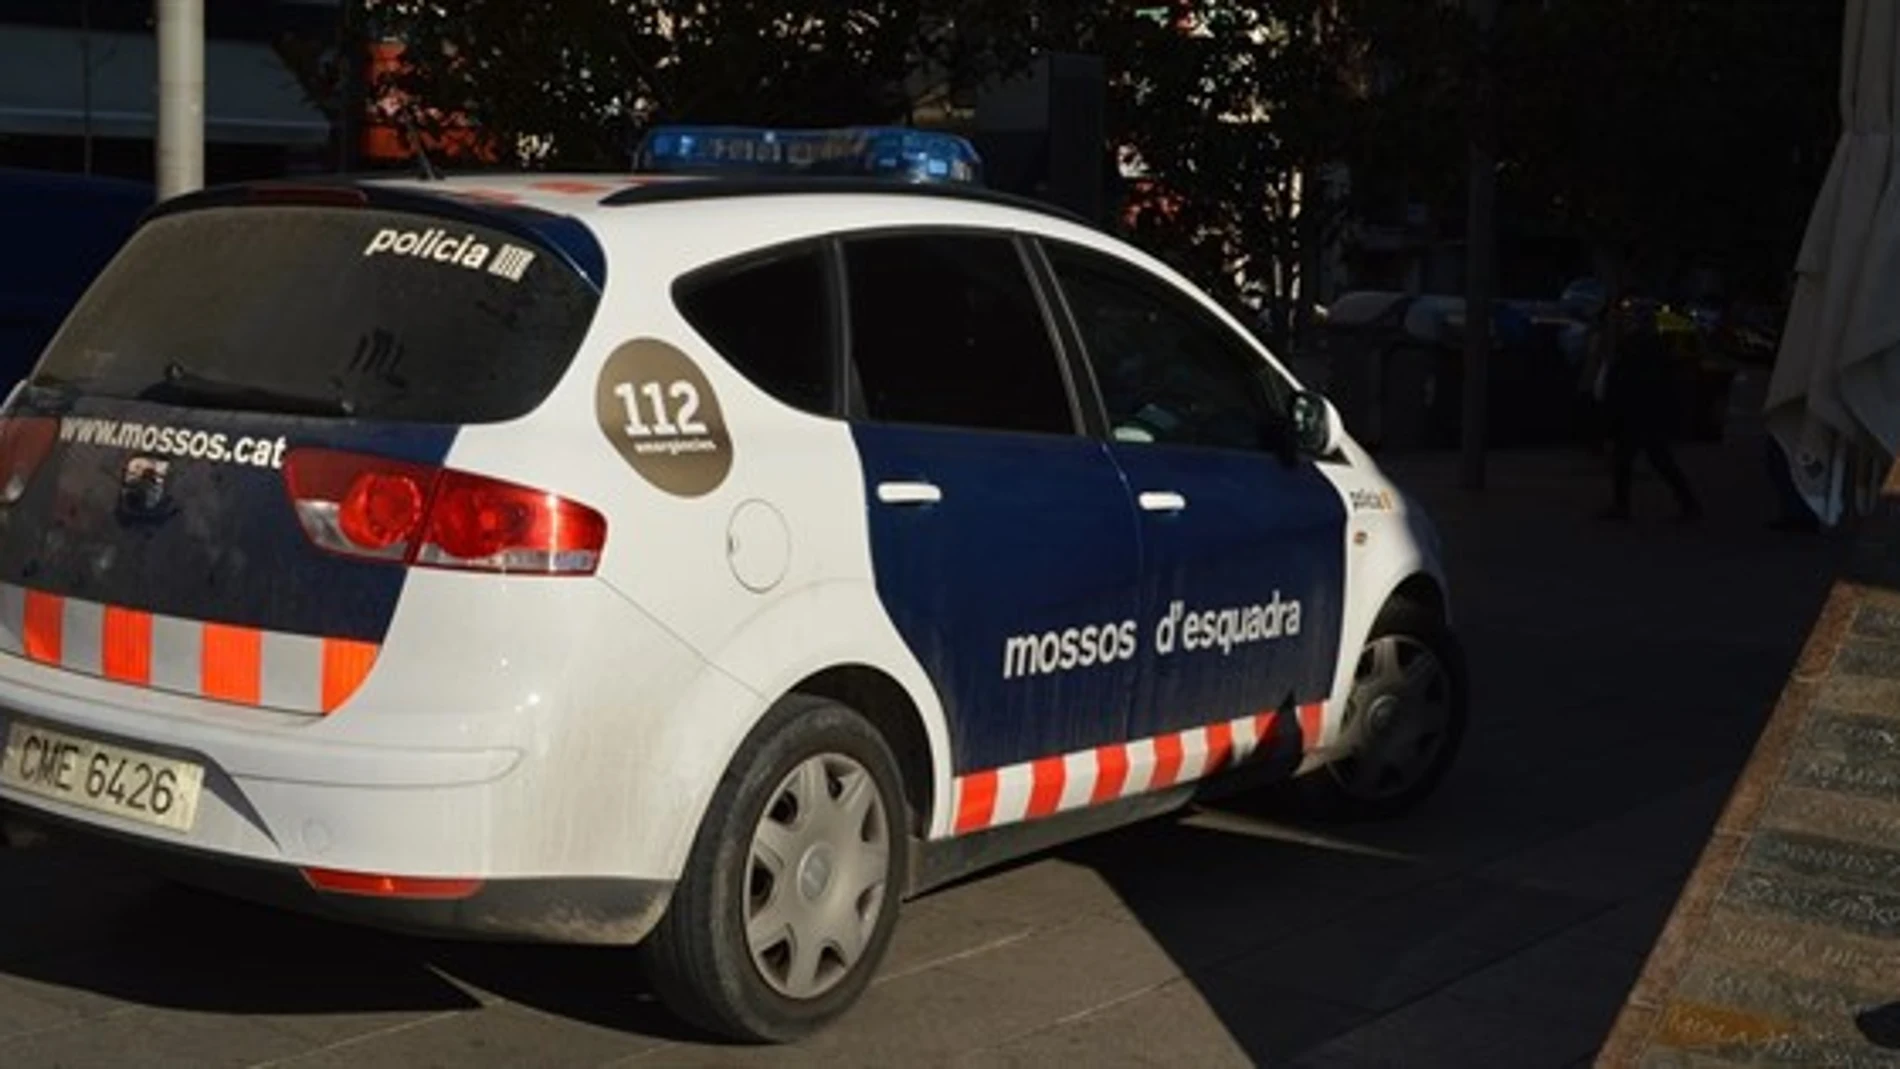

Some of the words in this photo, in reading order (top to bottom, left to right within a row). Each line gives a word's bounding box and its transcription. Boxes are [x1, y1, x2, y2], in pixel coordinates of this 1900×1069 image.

[364, 228, 490, 269] policia
[613, 380, 709, 436] 112
[59, 416, 287, 470] www.mossos.cat
[1003, 619, 1137, 679] mossos
[1155, 589, 1300, 655] d'esquadra
[19, 734, 79, 792] CME
[85, 751, 177, 815] 6426
